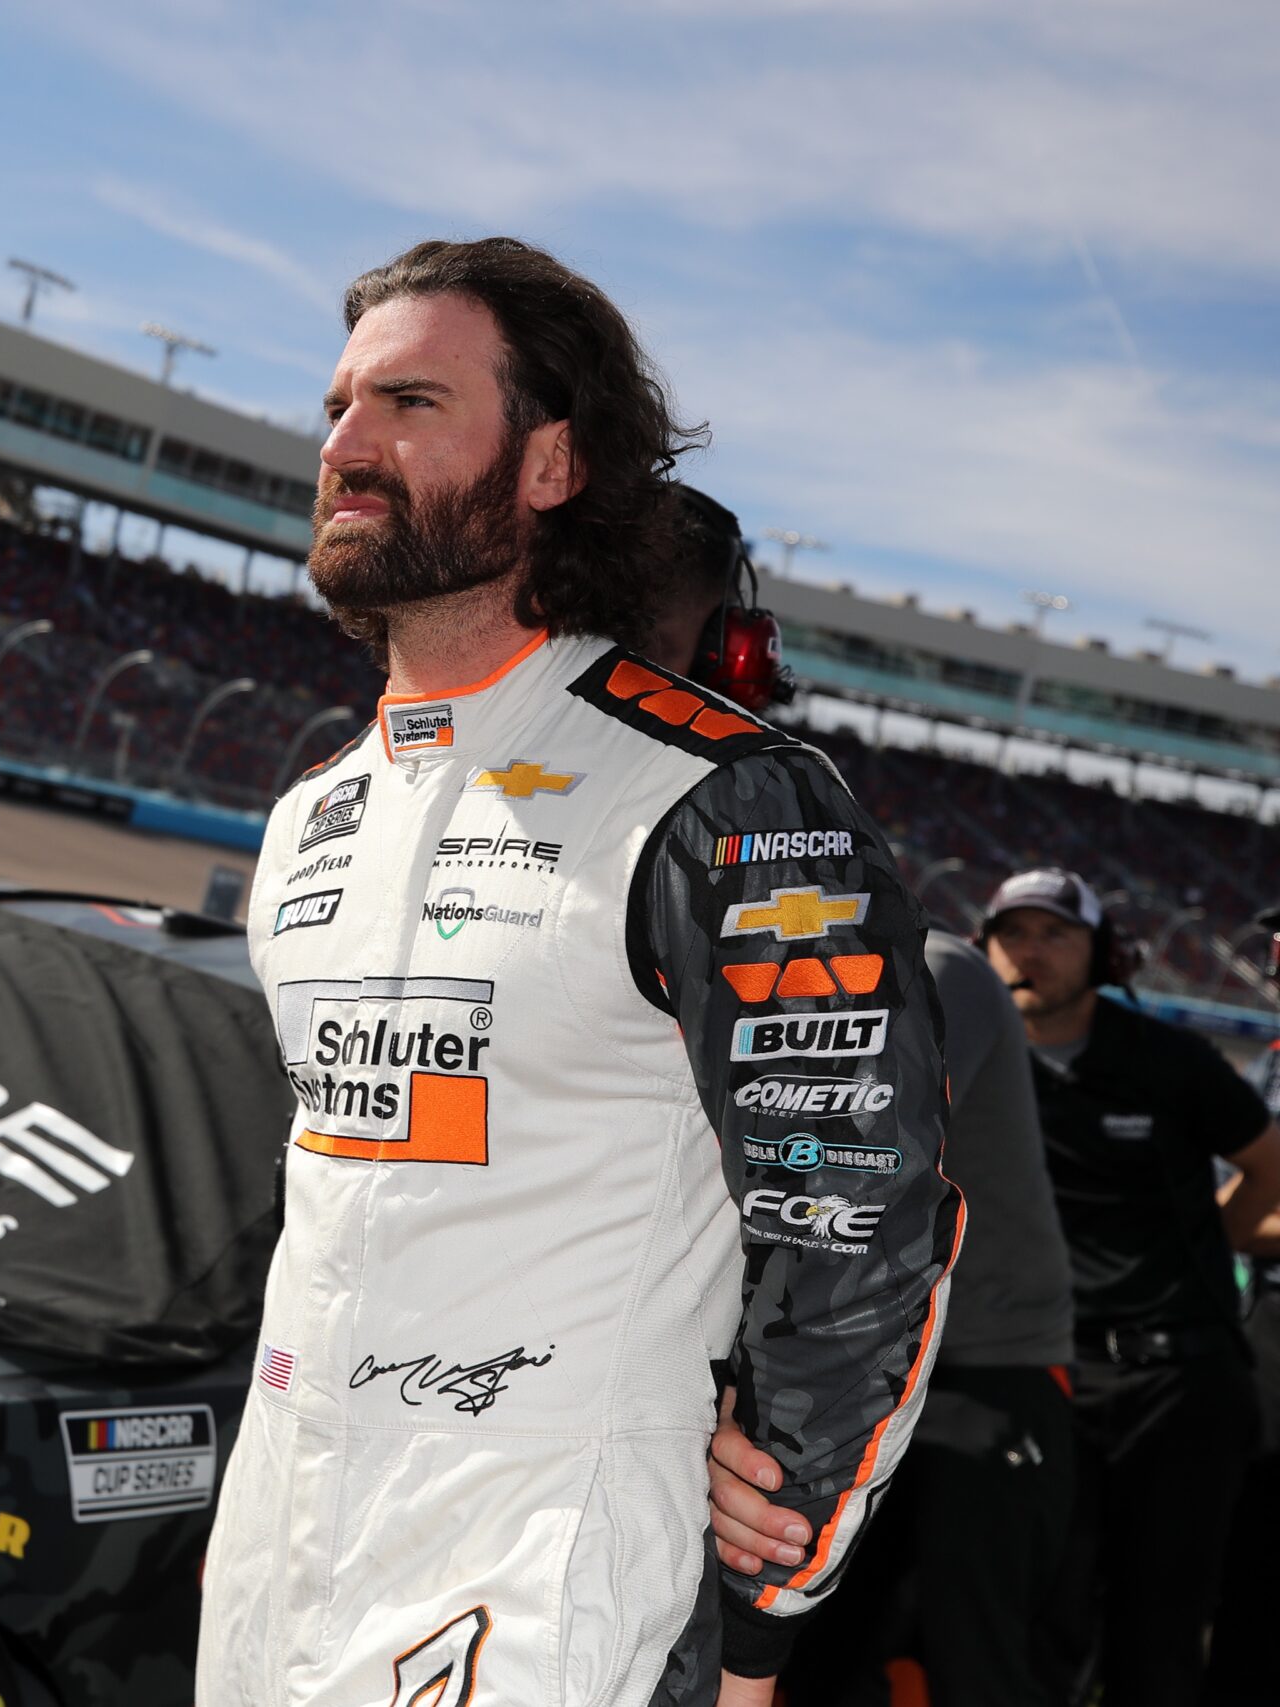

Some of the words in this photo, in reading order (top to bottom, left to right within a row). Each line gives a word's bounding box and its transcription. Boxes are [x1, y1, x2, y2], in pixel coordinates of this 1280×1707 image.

[393, 730, 436, 745] Systems
[406, 716, 453, 730] Schluter
[325, 807, 356, 828] SERIES
[436, 822, 564, 862] SPIRE
[751, 831, 854, 862] NASCAR
[431, 860, 556, 874] MOTORSPORTS
[282, 893, 340, 931] BUILT
[422, 902, 544, 929] NationsGuard
[751, 1016, 884, 1055] BUILT
[289, 1070, 400, 1120] Systms
[735, 1081, 894, 1112] COMETIC
[786, 1140, 819, 1166] B
[826, 1150, 898, 1168] DIECAST
[763, 1231, 782, 1241] ORDER
[782, 1235, 792, 1243] OF
[792, 1238, 819, 1249] EAGLES
[115, 1414, 194, 1449] NASCAR
[94, 1465, 130, 1494] CUP
[133, 1459, 196, 1491] SERIES
